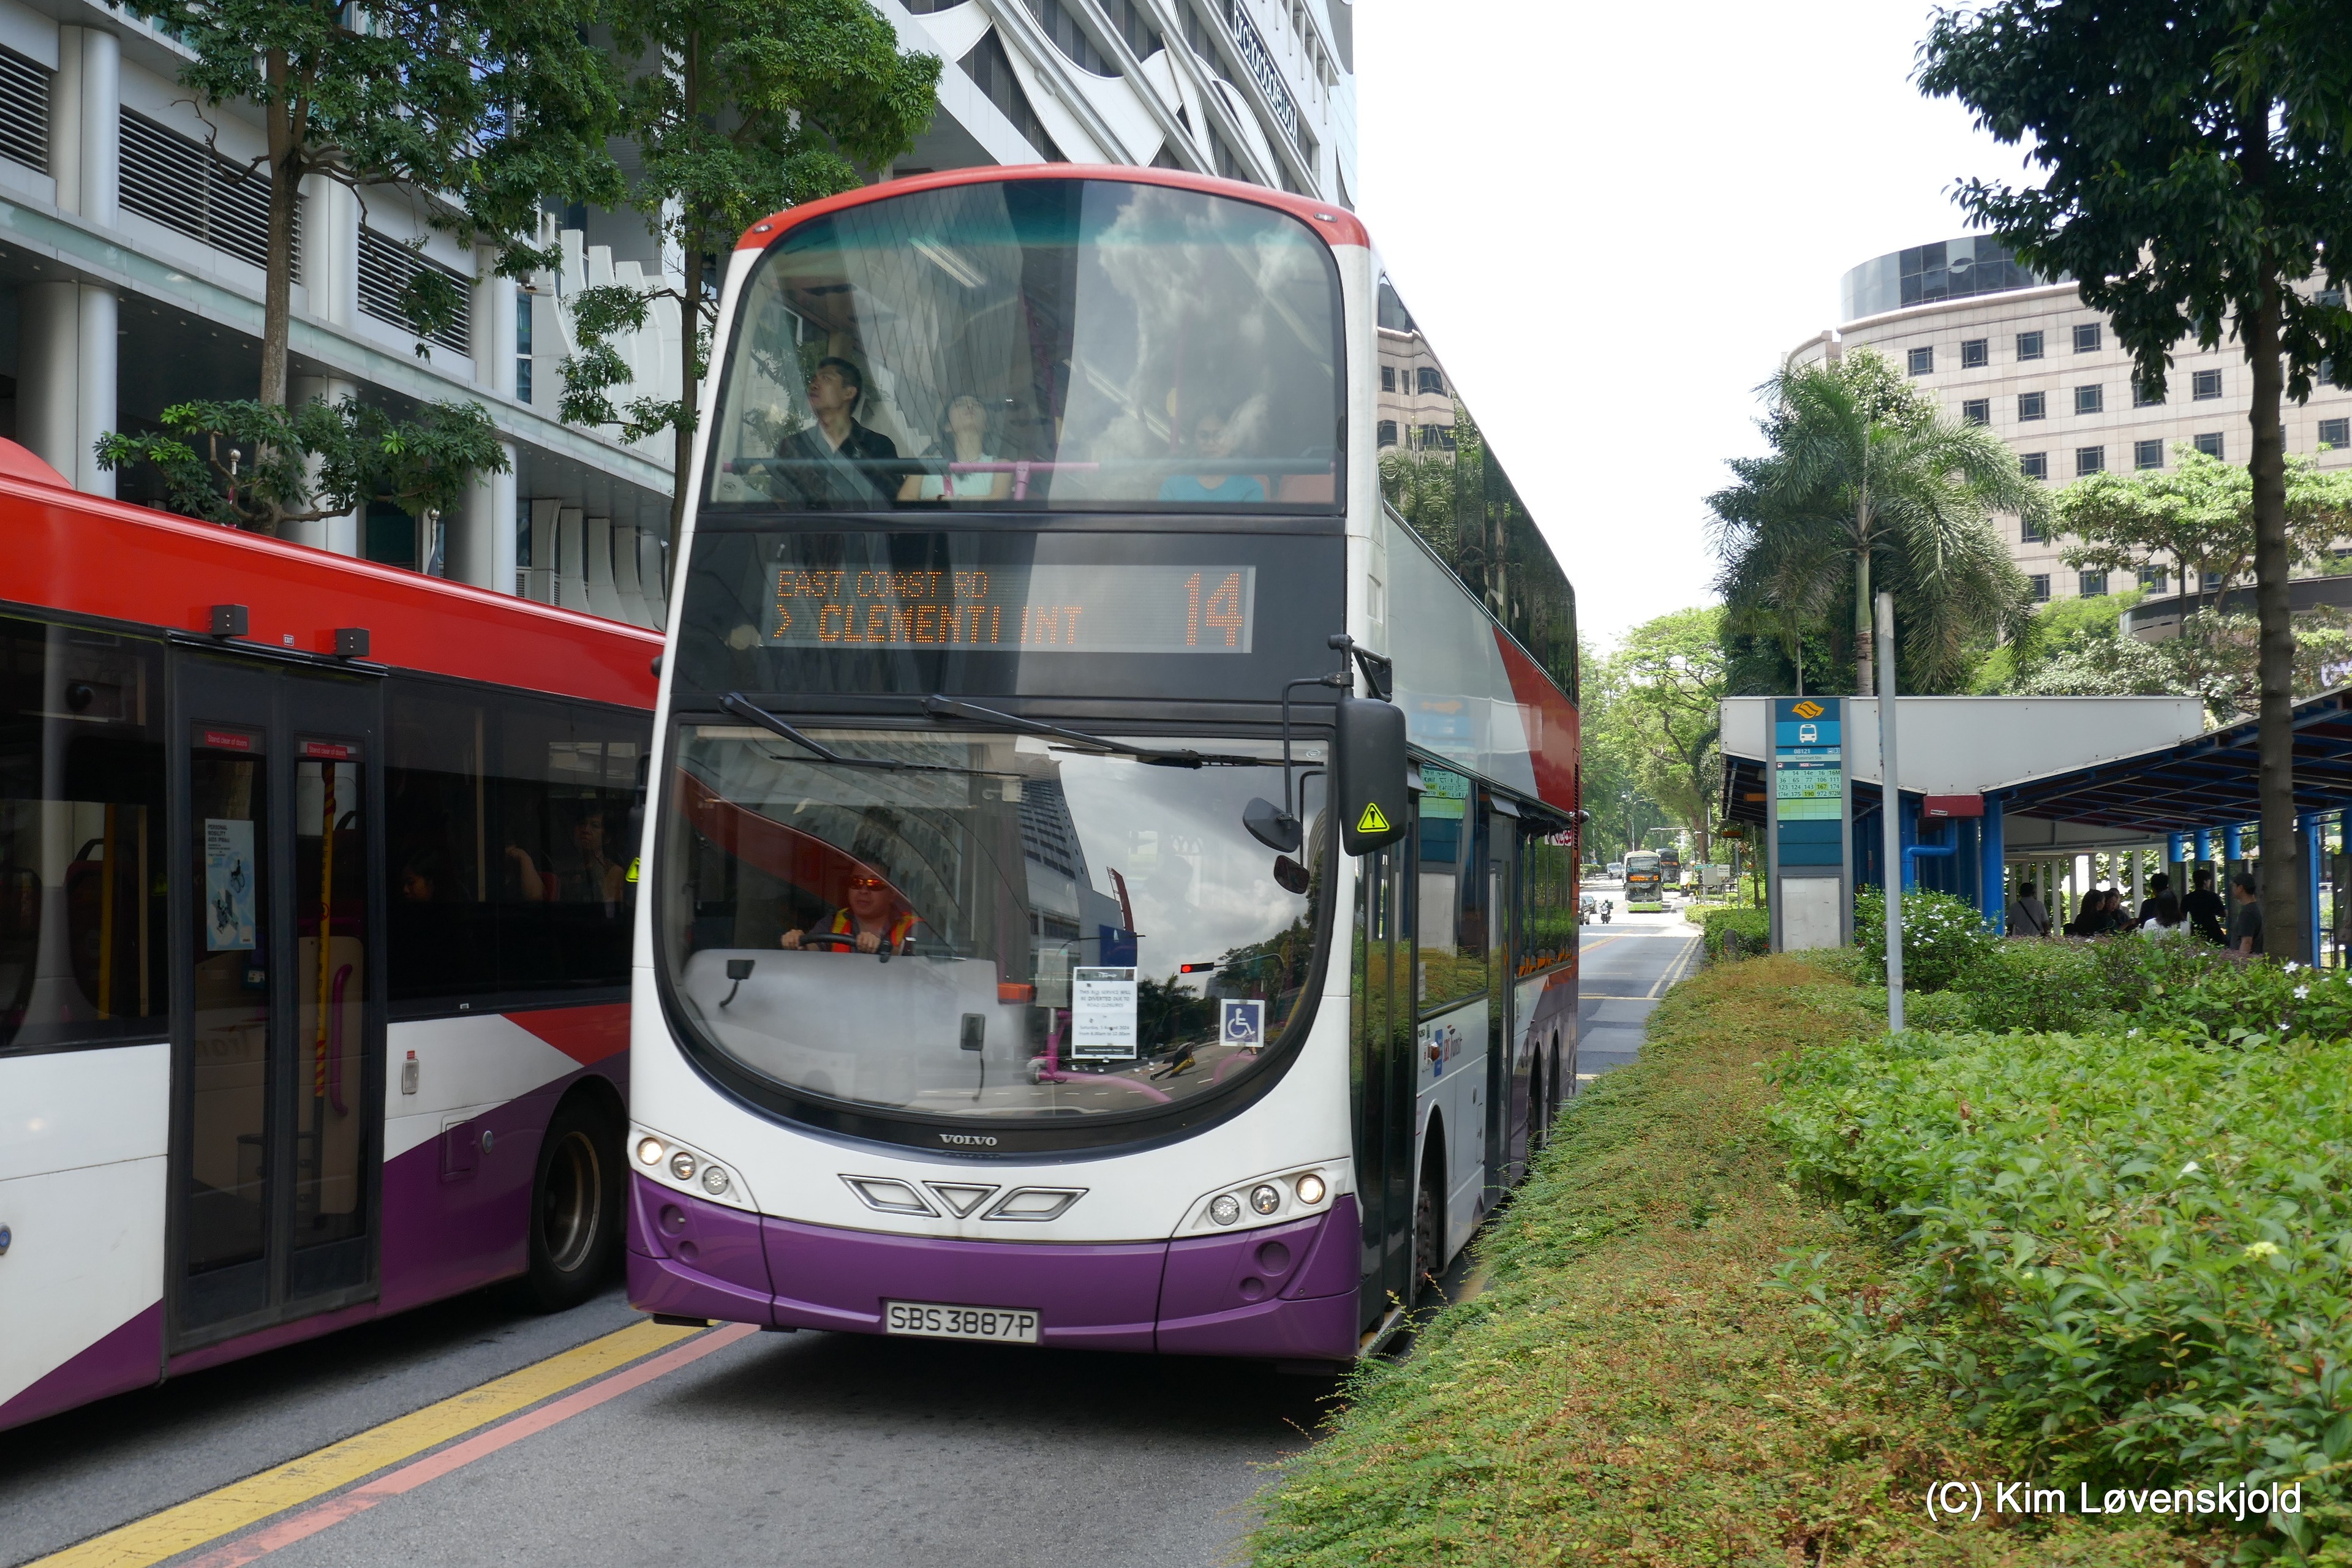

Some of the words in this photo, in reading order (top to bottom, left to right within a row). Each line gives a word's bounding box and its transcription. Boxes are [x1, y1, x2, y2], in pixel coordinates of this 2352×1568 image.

[776, 570, 846, 598] EAST
[856, 570, 943, 598] COAST
[953, 571, 988, 599] RD
[818, 603, 1001, 644] CLEMENTI
[1020, 606, 1083, 645] INT
[1183, 572, 1243, 647] 14
[208, 734, 221, 744] Stand
[221, 736, 230, 745] clear
[236, 739, 248, 747] doors
[308, 745, 320, 754] Stand
[939, 1134, 998, 1147] VOLVO
[891, 1306, 1035, 1338] SBS3887P
